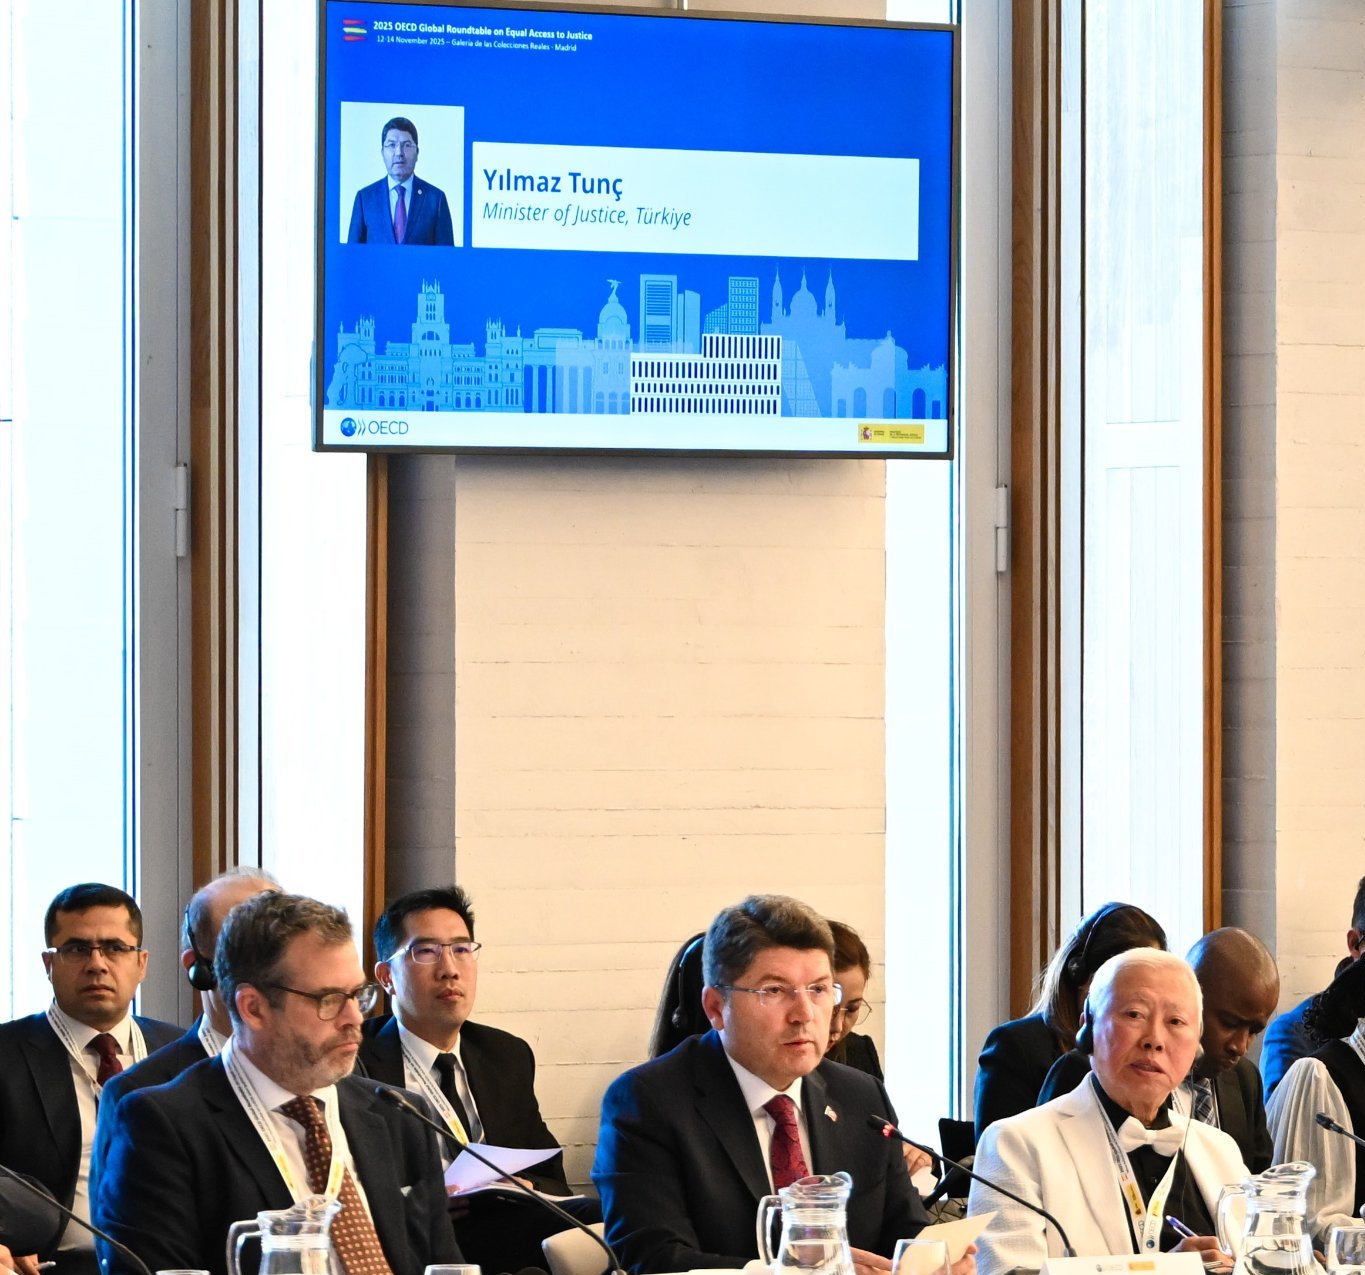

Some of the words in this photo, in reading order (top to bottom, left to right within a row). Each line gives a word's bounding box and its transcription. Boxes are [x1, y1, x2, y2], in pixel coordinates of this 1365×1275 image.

[373, 21, 392, 29] 2025
[395, 22, 416, 31] OECD
[419, 23, 444, 32] Global
[446, 24, 491, 34] Roundtable
[506, 27, 526, 37] Equal
[529, 29, 554, 38] Access
[566, 31, 592, 39] Justice
[430, 38, 445, 46] 2025
[555, 43, 577, 52] Madrid
[483, 168, 560, 192] Yılmaz
[568, 172, 622, 201] Tunç
[483, 202, 548, 221] Minister
[554, 204, 572, 226] of
[572, 205, 629, 226] Justice,
[636, 207, 691, 230] Türkiye
[368, 420, 408, 434] OECD
